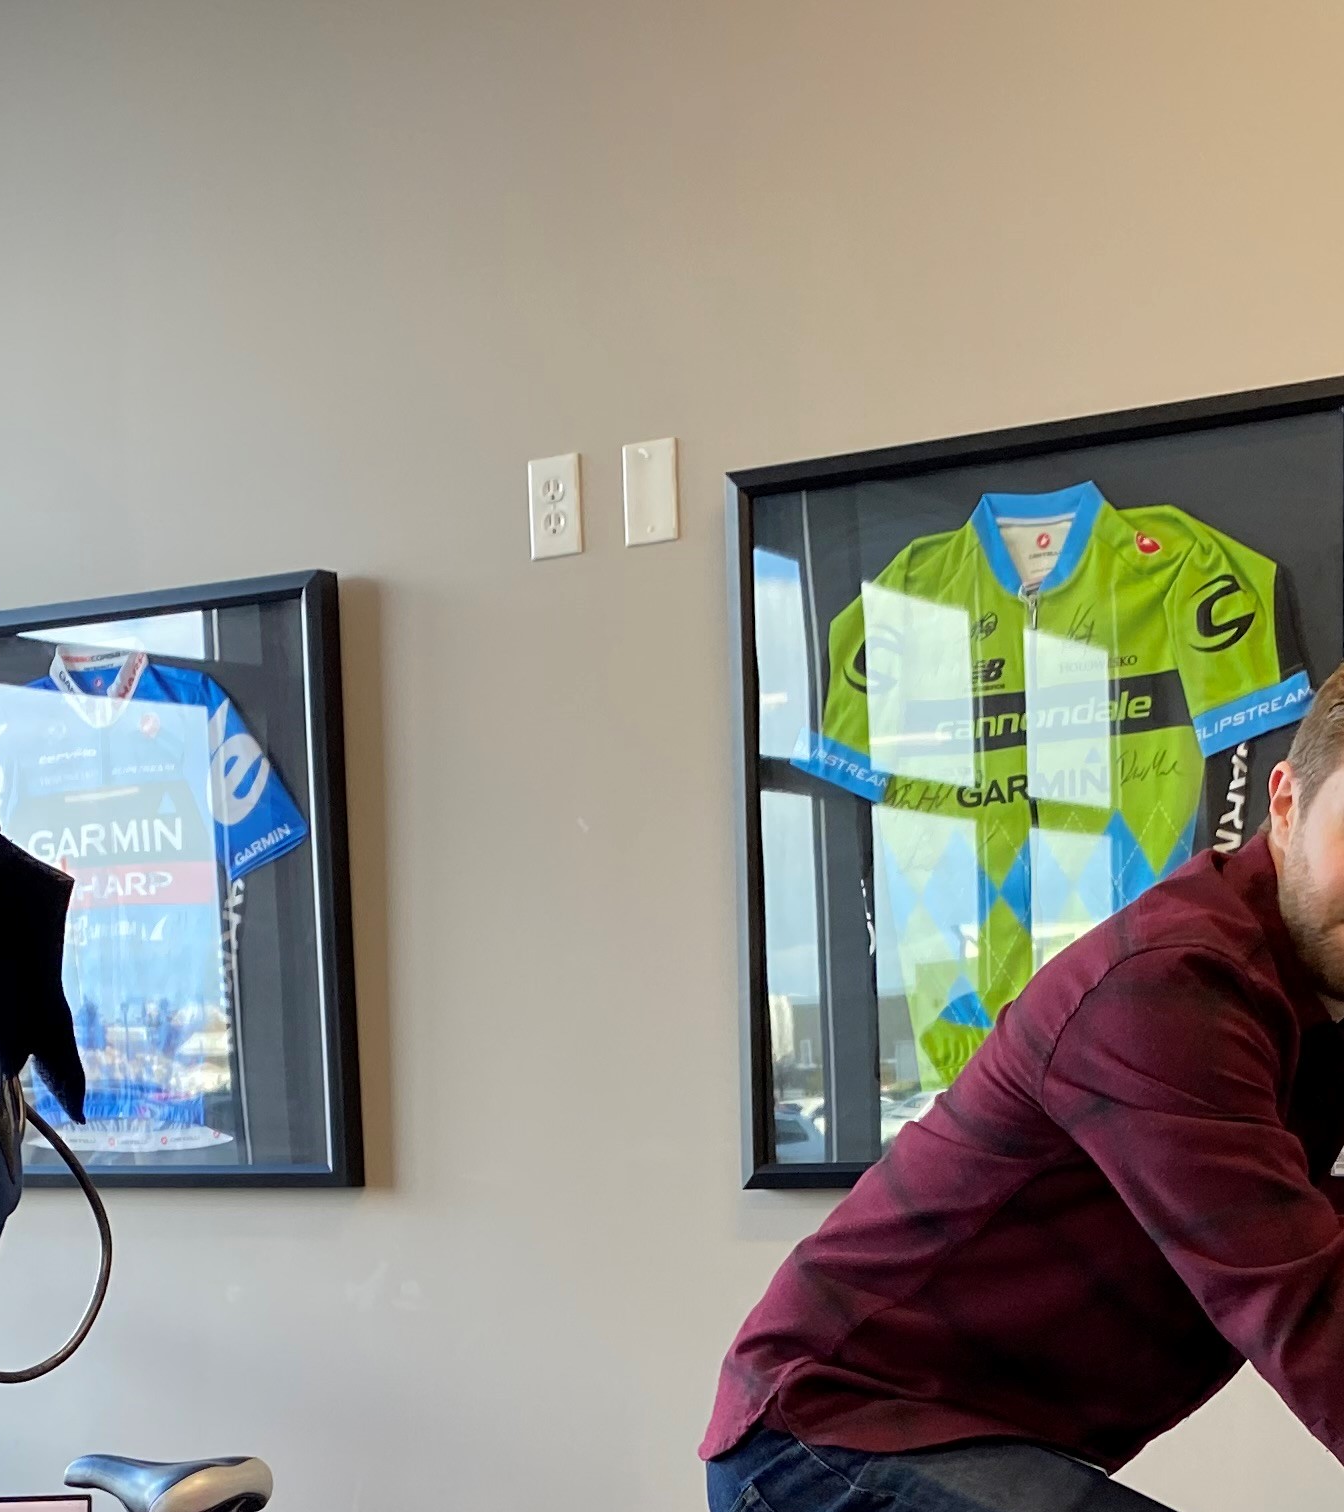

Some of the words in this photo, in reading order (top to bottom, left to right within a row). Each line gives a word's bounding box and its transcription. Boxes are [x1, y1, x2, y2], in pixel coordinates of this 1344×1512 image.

[935, 691, 1153, 740] cannondale
[957, 766, 1109, 809] GARMIN
[27, 816, 183, 863] GARMIN
[233, 823, 291, 867] GARMIN
[75, 870, 174, 900] HARP
